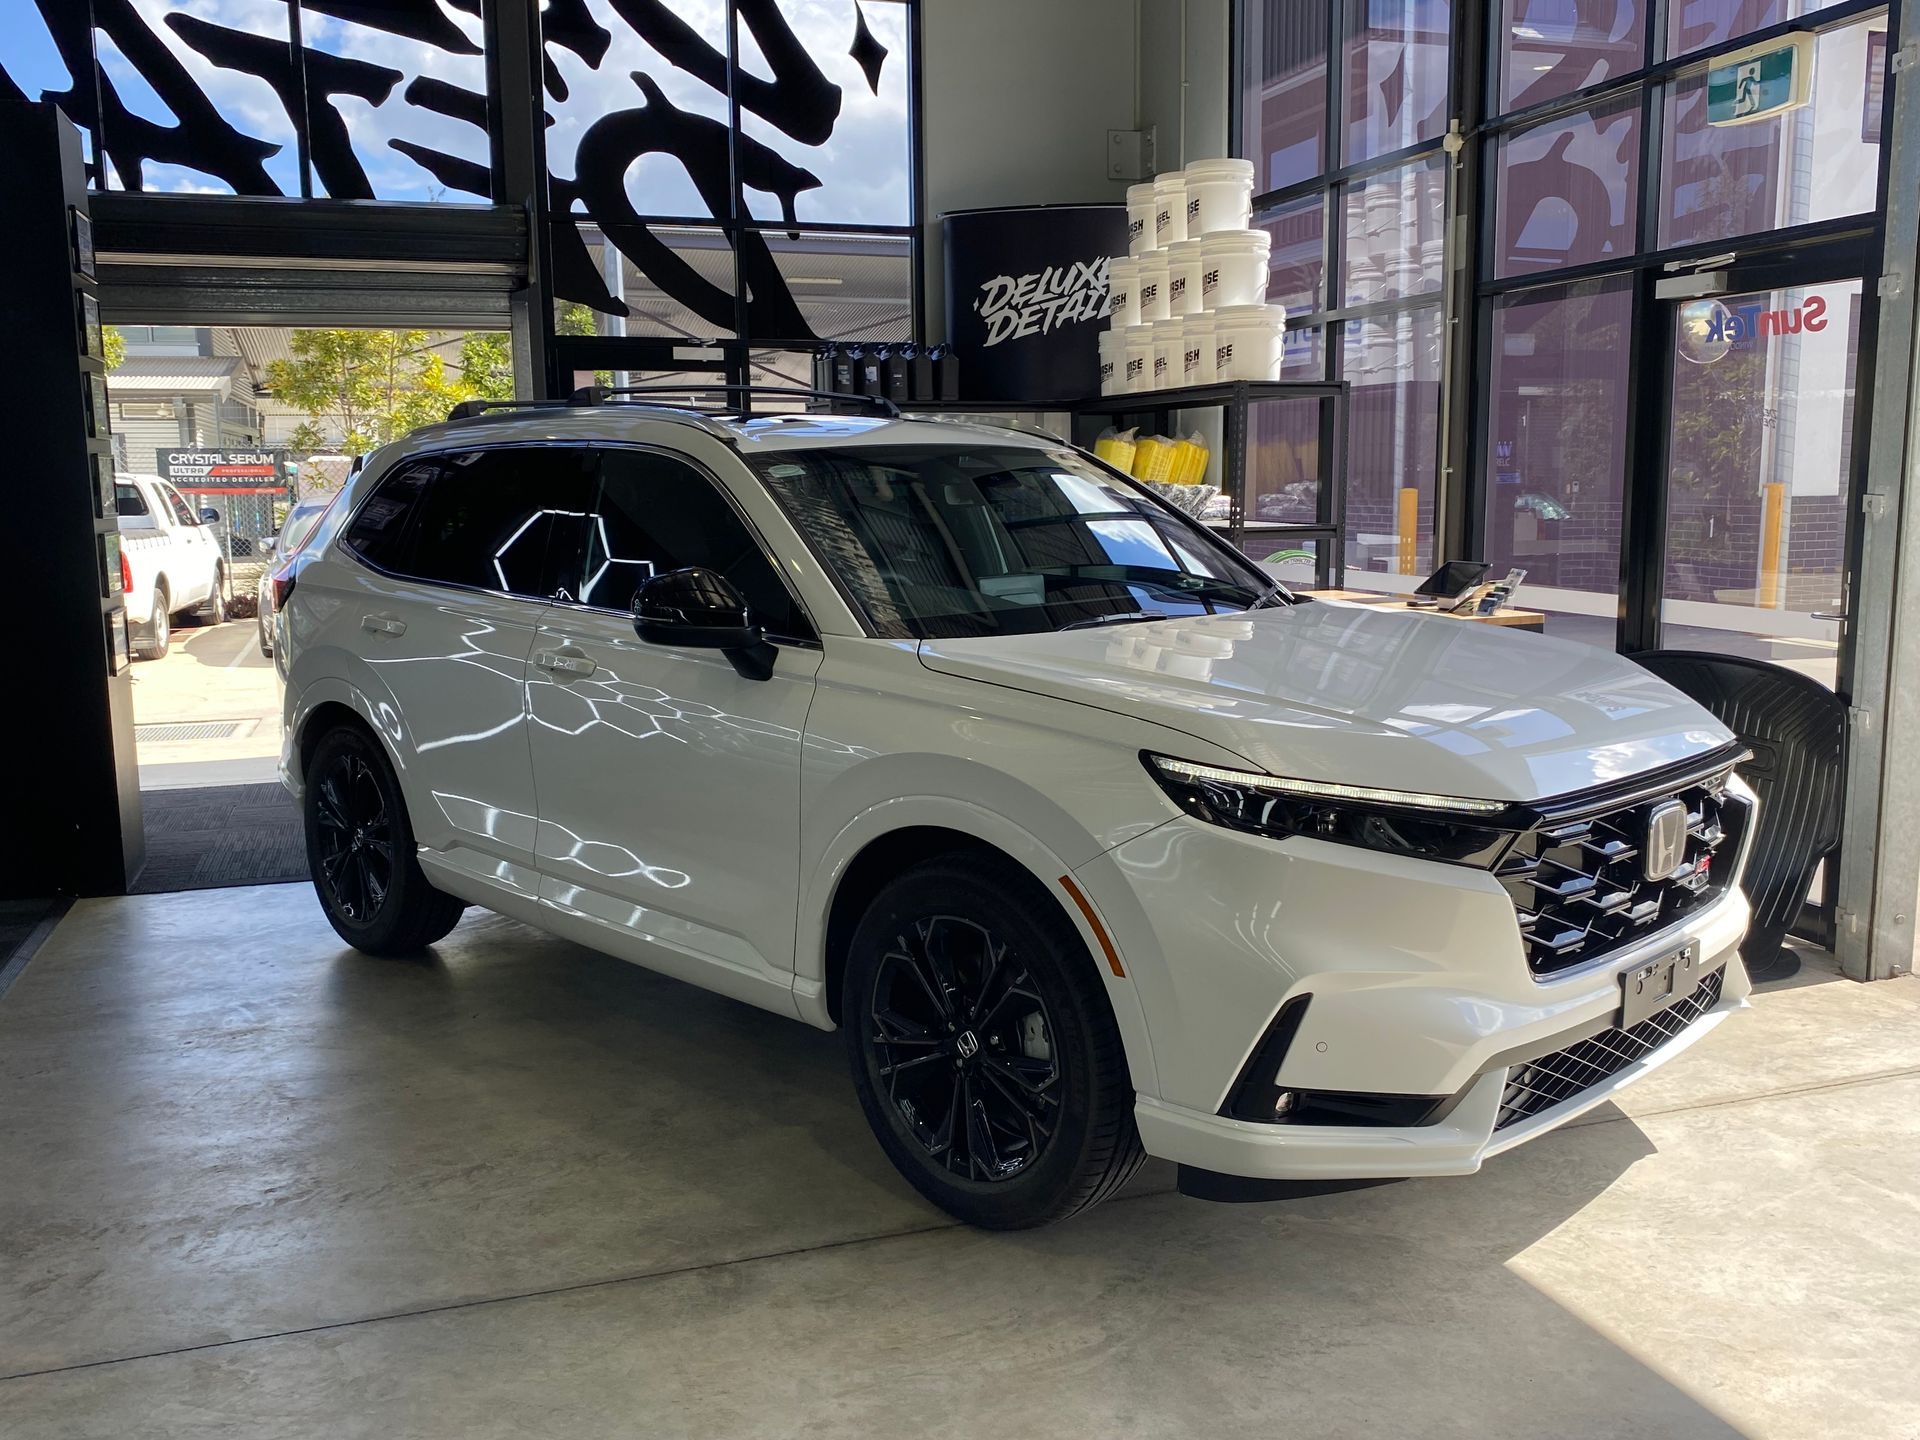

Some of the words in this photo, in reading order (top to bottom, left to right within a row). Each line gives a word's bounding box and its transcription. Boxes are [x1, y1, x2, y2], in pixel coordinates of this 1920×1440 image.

[1169, 277, 1186, 293] ASH
[1110, 292, 1127, 308] ASH
[1184, 349, 1200, 363] ASH
[168, 453, 226, 465] CRYSTAL
[228, 453, 274, 465] SERUM
